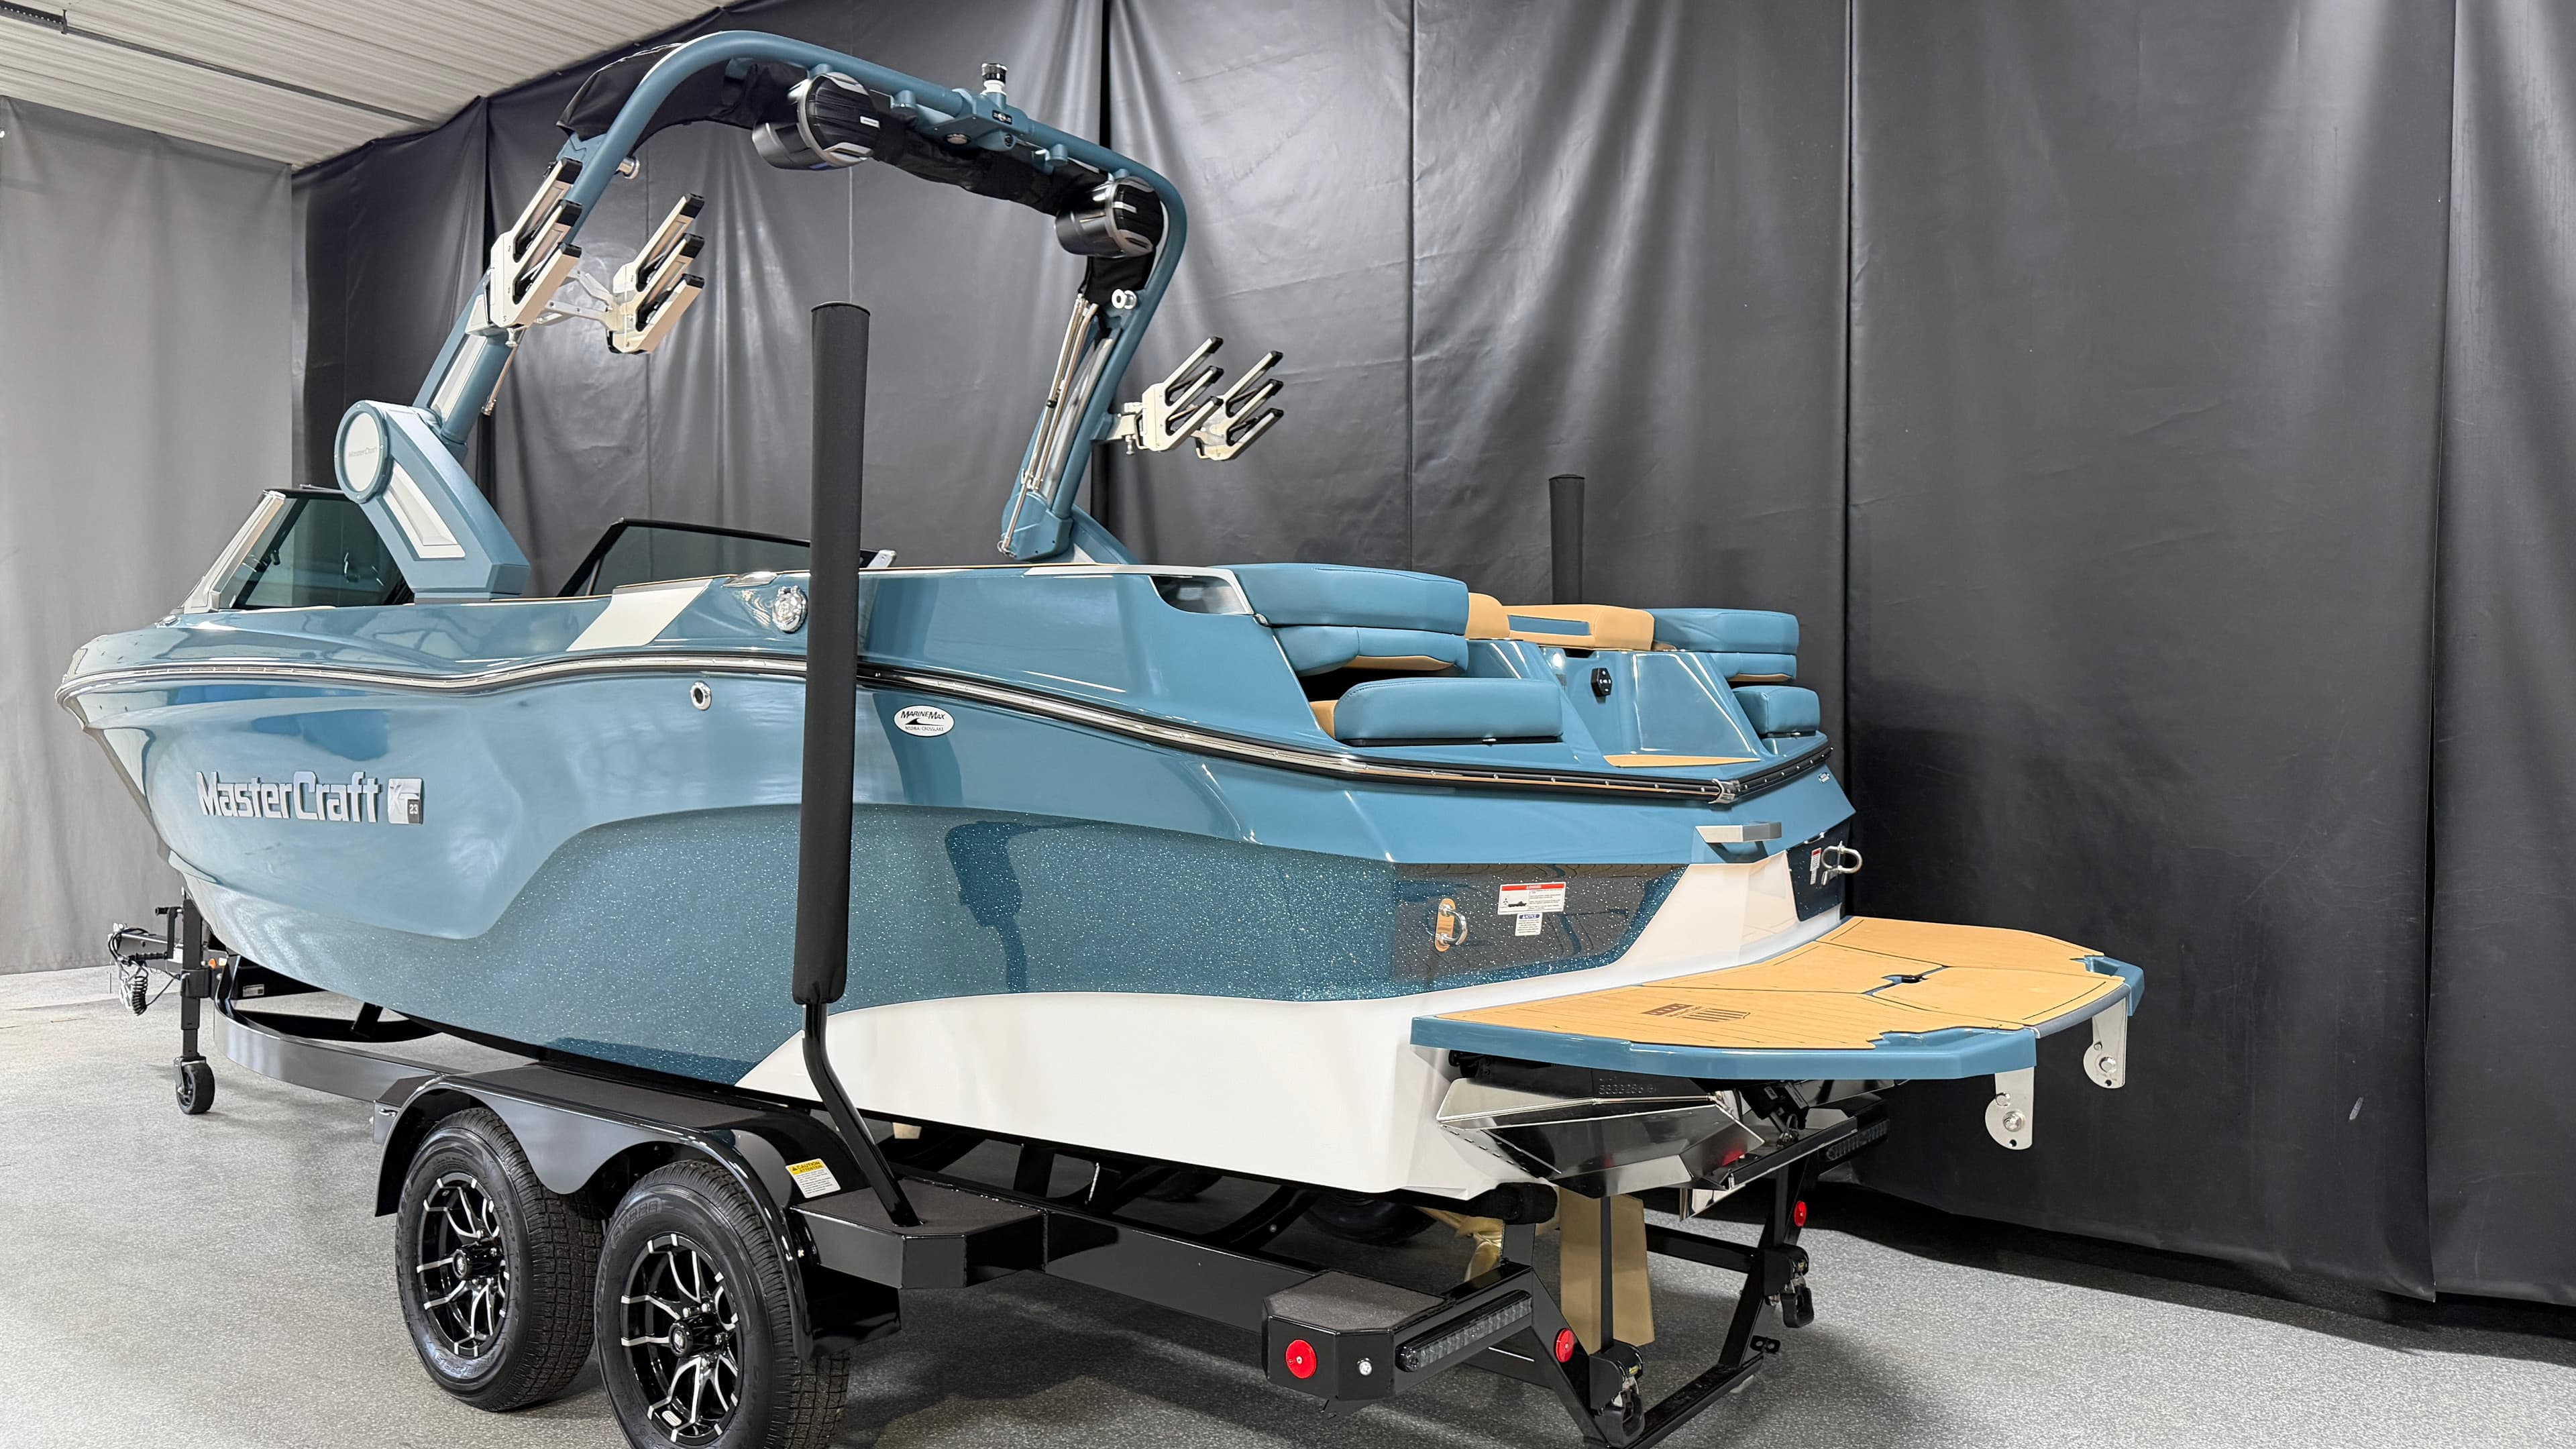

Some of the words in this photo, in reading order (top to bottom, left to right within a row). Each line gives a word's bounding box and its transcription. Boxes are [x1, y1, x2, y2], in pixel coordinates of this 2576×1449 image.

[196, 771, 382, 822] MasterCraft
[409, 804, 419, 814] 23
[796, 1161, 820, 1169] CAUTION
